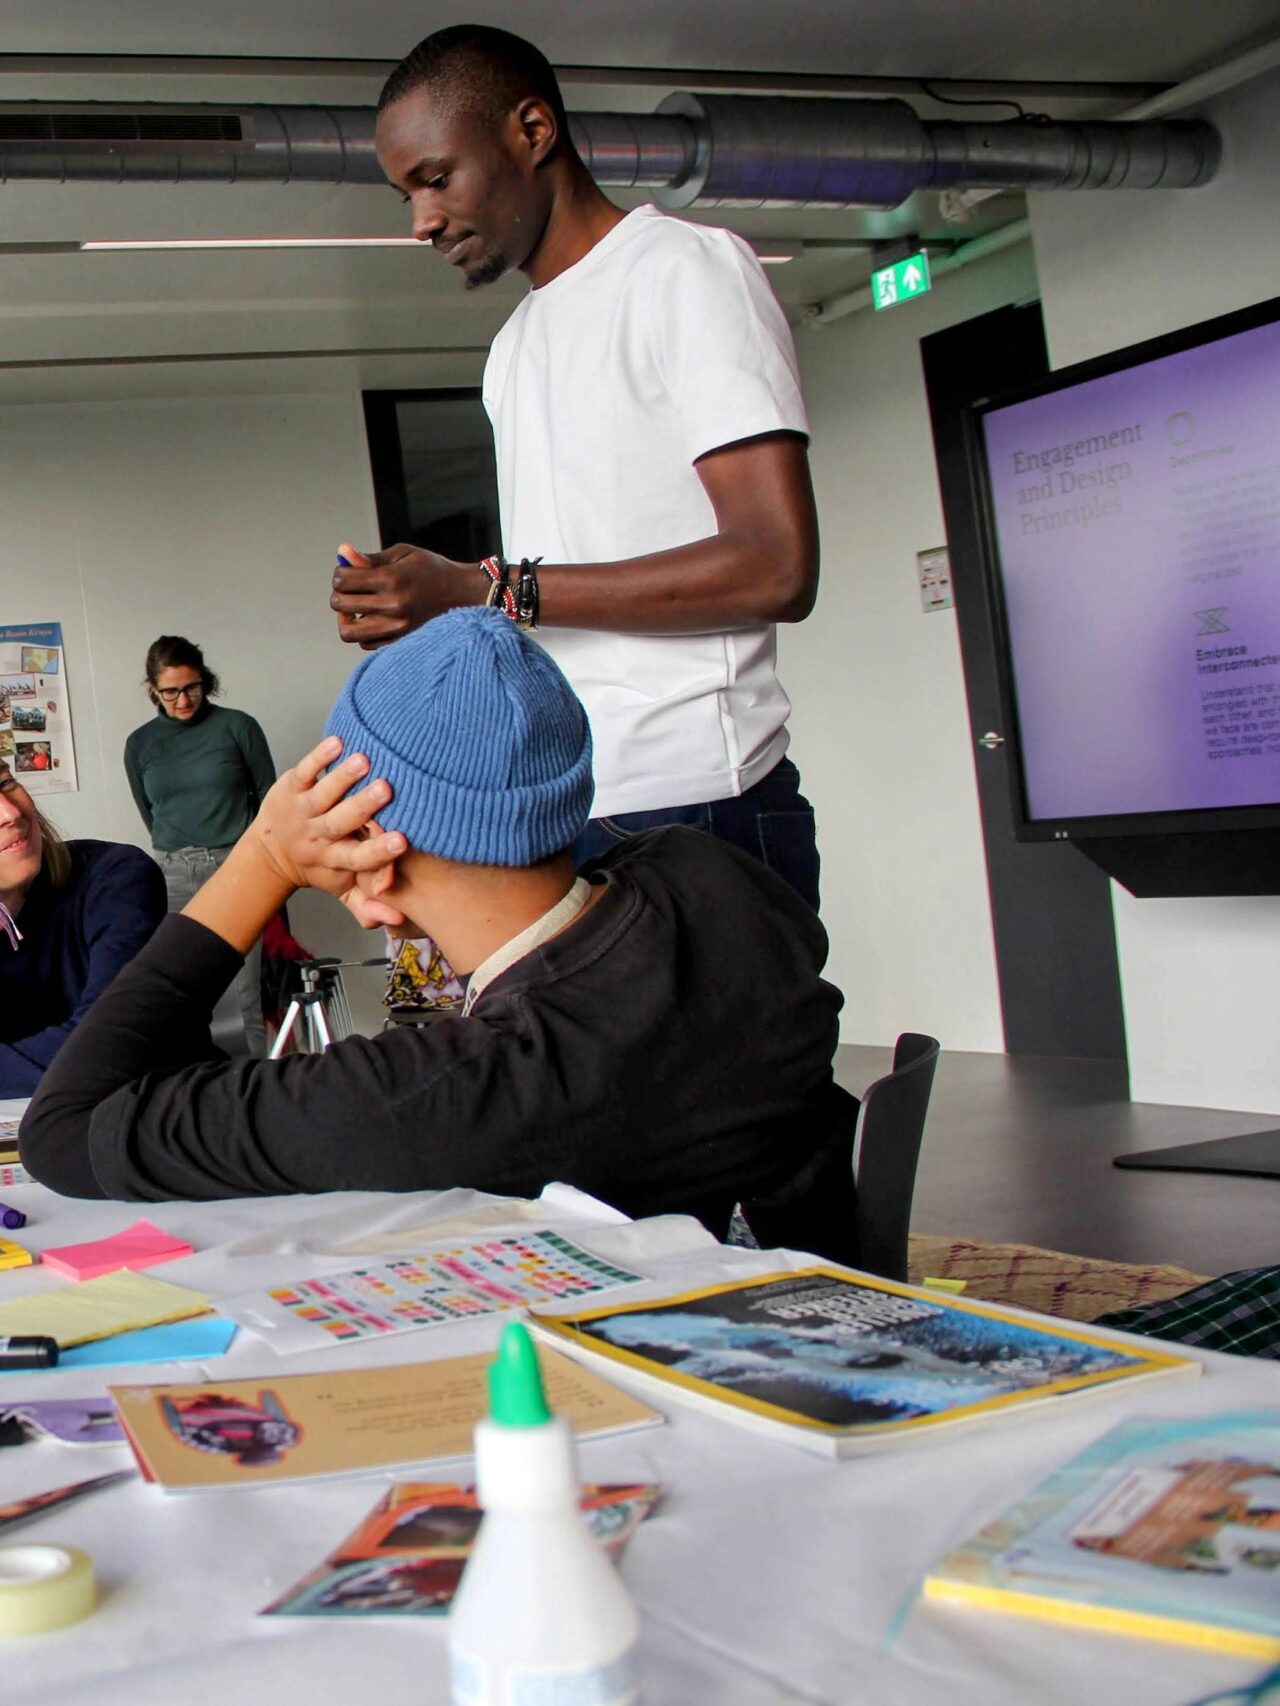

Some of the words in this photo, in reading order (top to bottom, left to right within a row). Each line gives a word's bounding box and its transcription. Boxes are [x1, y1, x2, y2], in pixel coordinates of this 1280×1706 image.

[1012, 424, 1143, 474] Engagement
[1017, 475, 1054, 505] and
[1059, 461, 1132, 494] Design
[1021, 495, 1122, 536] Principles
[1195, 645, 1248, 661] Embrace
[1197, 655, 1280, 674] Interconnecte
